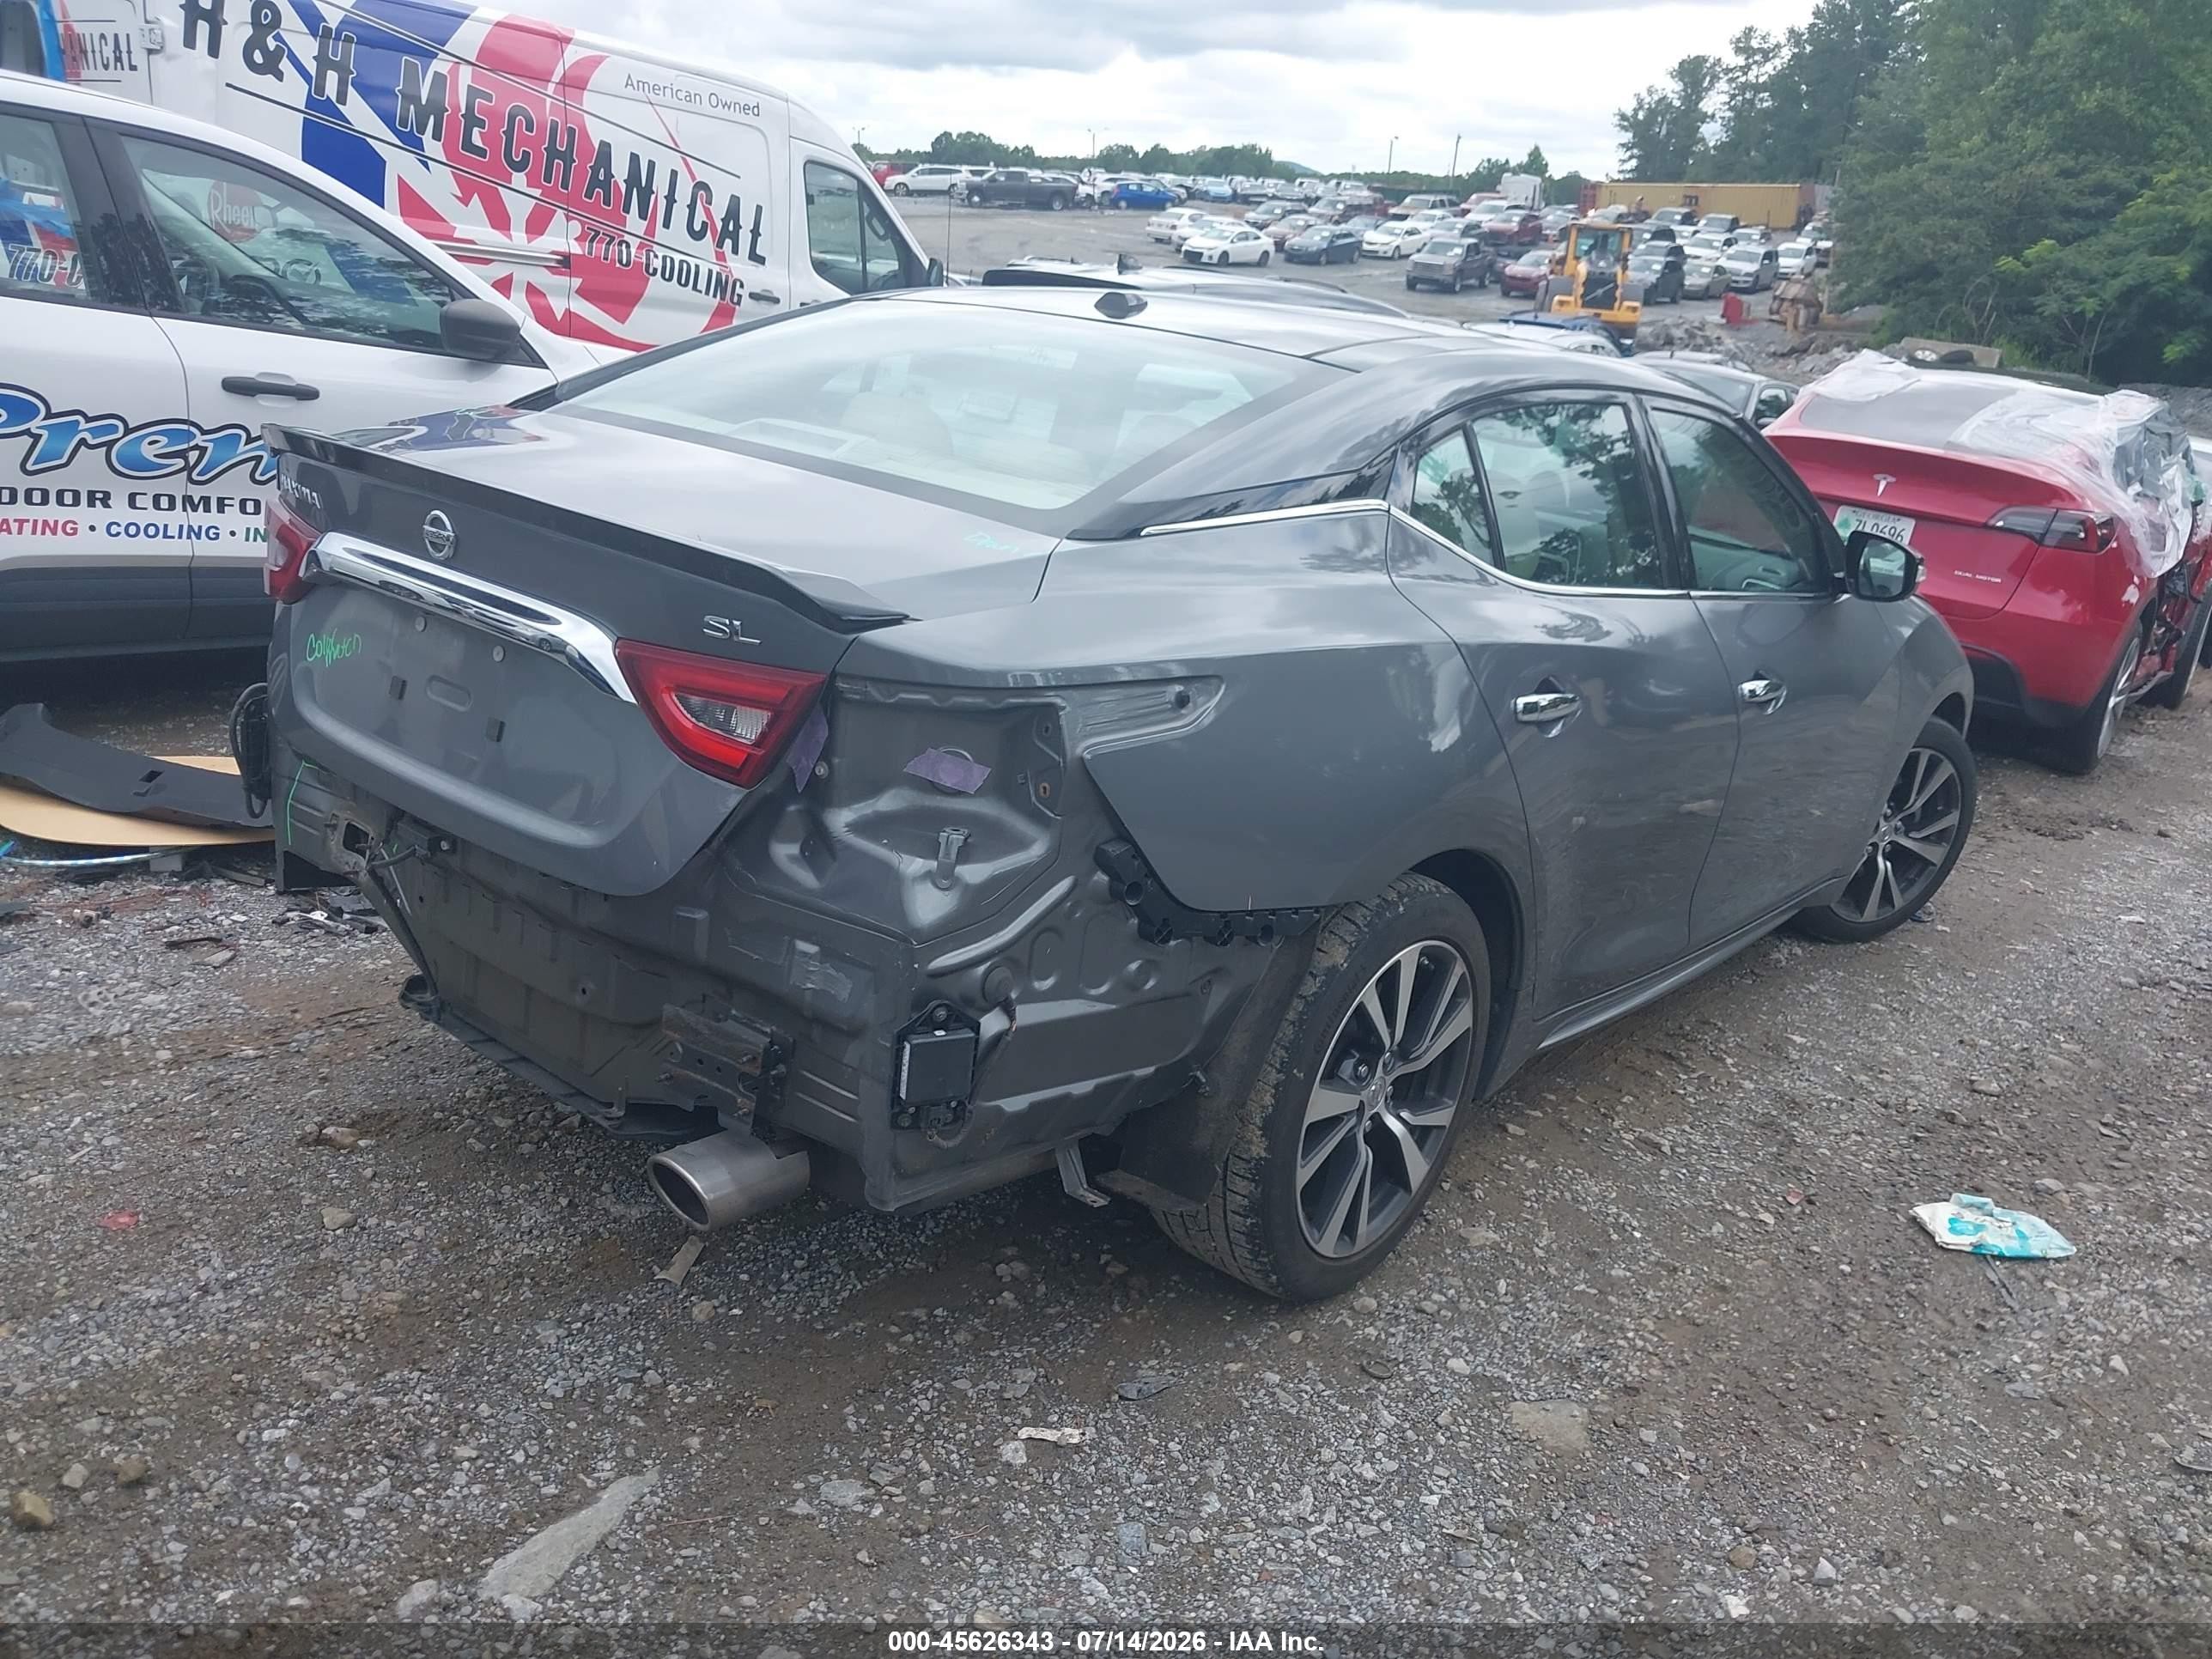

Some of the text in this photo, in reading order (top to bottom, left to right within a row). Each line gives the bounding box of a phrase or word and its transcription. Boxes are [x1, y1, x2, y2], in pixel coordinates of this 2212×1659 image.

[624, 73, 761, 117] American Owned
[179, 0, 767, 266] H & H MECHANICAL
[586, 226, 744, 307] 770-COOLING
[128, 491, 261, 515] COMFO
[105, 521, 221, 542] COOLING
[702, 615, 762, 645] SL
